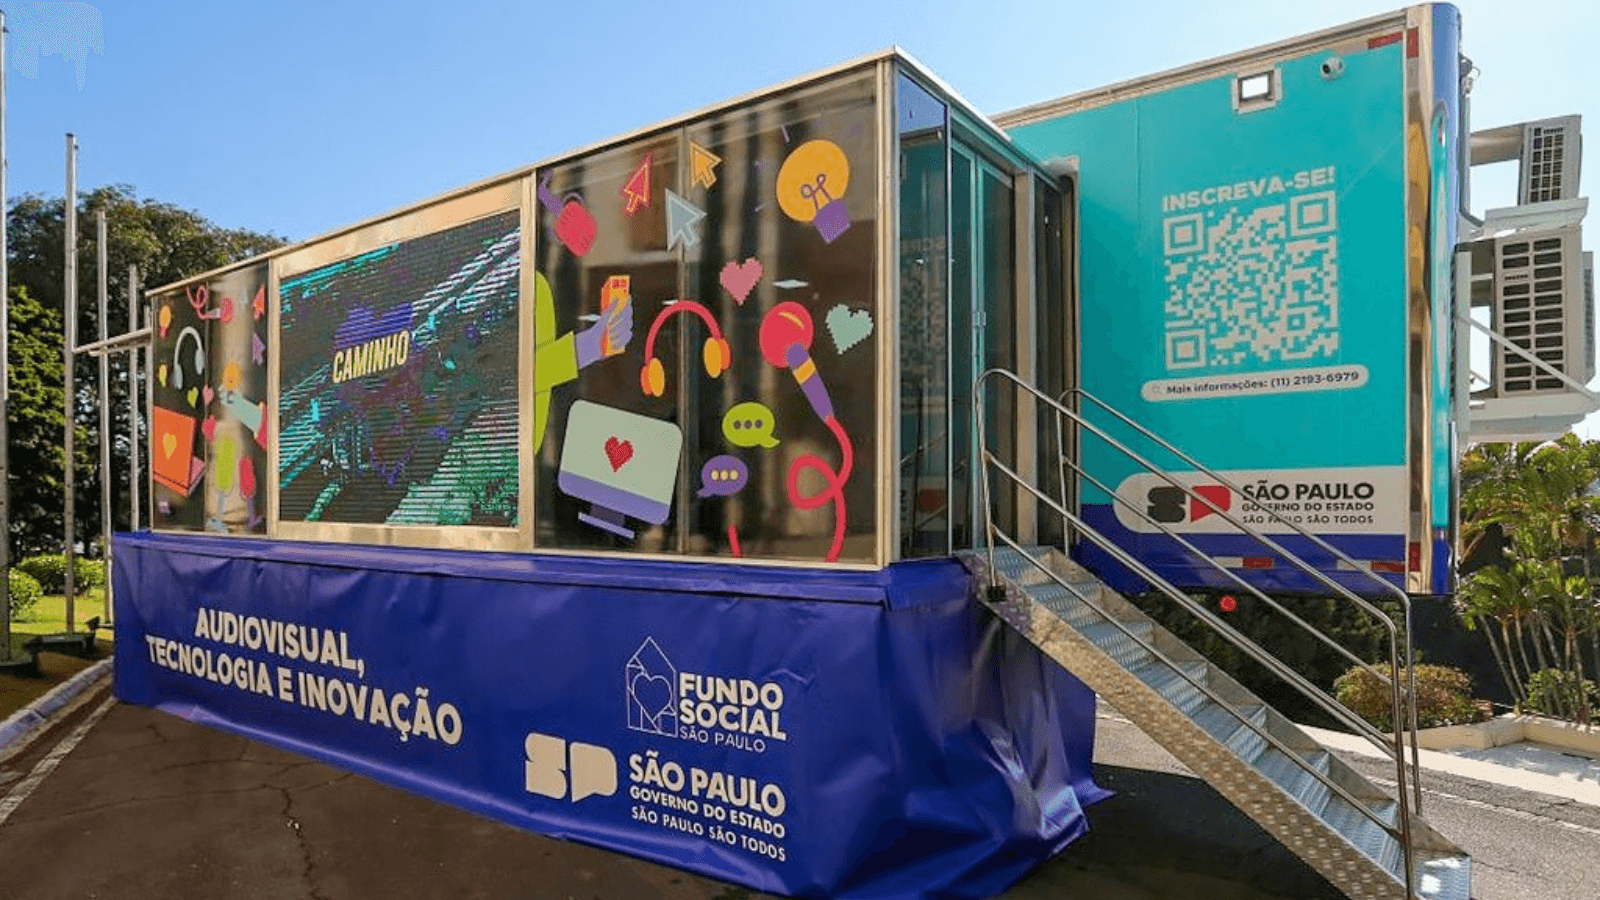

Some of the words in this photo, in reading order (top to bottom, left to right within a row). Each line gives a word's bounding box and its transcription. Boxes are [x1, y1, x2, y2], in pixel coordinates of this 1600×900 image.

[1162, 165, 1336, 212] INSCREVA-SE!
[332, 330, 410, 383] CAMINHO
[1166, 383, 1191, 394] Mais
[1193, 379, 1268, 391] informações:
[1271, 377, 1290, 388] (11)
[1293, 371, 1359, 385] 2193-6979
[1241, 502, 1300, 511] GOERNO
[1304, 502, 1322, 511] DO
[1326, 501, 1374, 511] ESTADO
[1242, 479, 1290, 501] SÃO
[1295, 482, 1374, 500] PAULO
[1242, 514, 1264, 523] SÃO
[1307, 514, 1330, 523] SÃO
[1334, 515, 1374, 523] TODOS
[194, 607, 365, 678] AUDIOVISUAL,
[145, 634, 273, 698] TECNOLOGIA
[277, 666, 294, 703] E
[298, 672, 463, 745] INOVAÇÃO
[679, 671, 784, 711] FUNDO
[679, 698, 787, 741] SOCIAL
[680, 725, 709, 743] SÃO
[715, 732, 766, 753] PAULO
[629, 750, 685, 791] SÃO
[691, 767, 786, 817] PAULO
[629, 784, 698, 814] GOVERNO
[703, 803, 726, 821] DO
[730, 809, 785, 838] ESTADO
[631, 804, 658, 824] SÃO
[663, 814, 703, 836] PAULO
[709, 826, 736, 845] SÃO
[741, 835, 786, 862] TODOS
